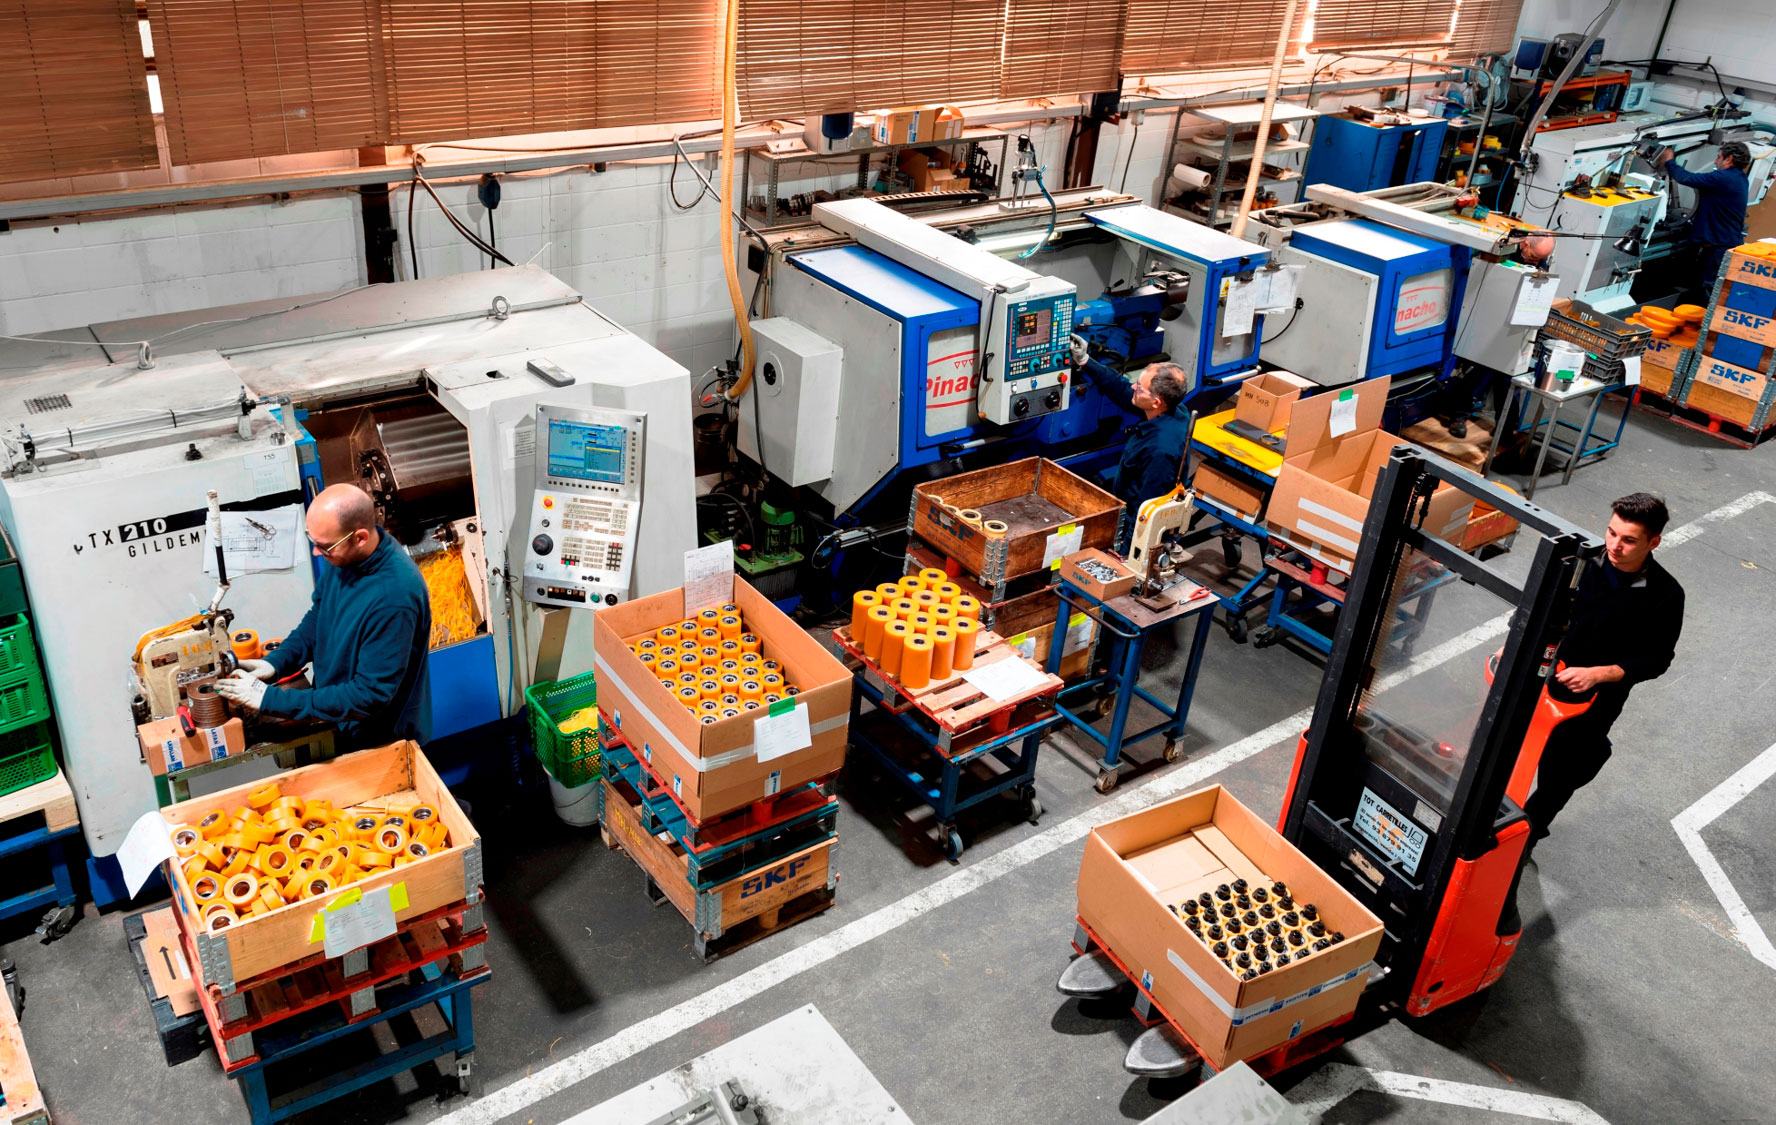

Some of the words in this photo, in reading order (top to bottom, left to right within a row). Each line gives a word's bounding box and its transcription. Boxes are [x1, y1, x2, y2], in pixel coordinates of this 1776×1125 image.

[1741, 261, 1776, 279] SK
[1396, 301, 1437, 322] nacho
[1724, 310, 1770, 329] SKF
[1710, 364, 1757, 384] SKF
[122, 517, 168, 542] 210
[127, 528, 208, 559] GILDEM
[1359, 814, 1370, 826] Tel.
[1363, 794, 1375, 807] TOT
[1375, 804, 1408, 833] CARRETILLES
[741, 855, 811, 899] SKF
